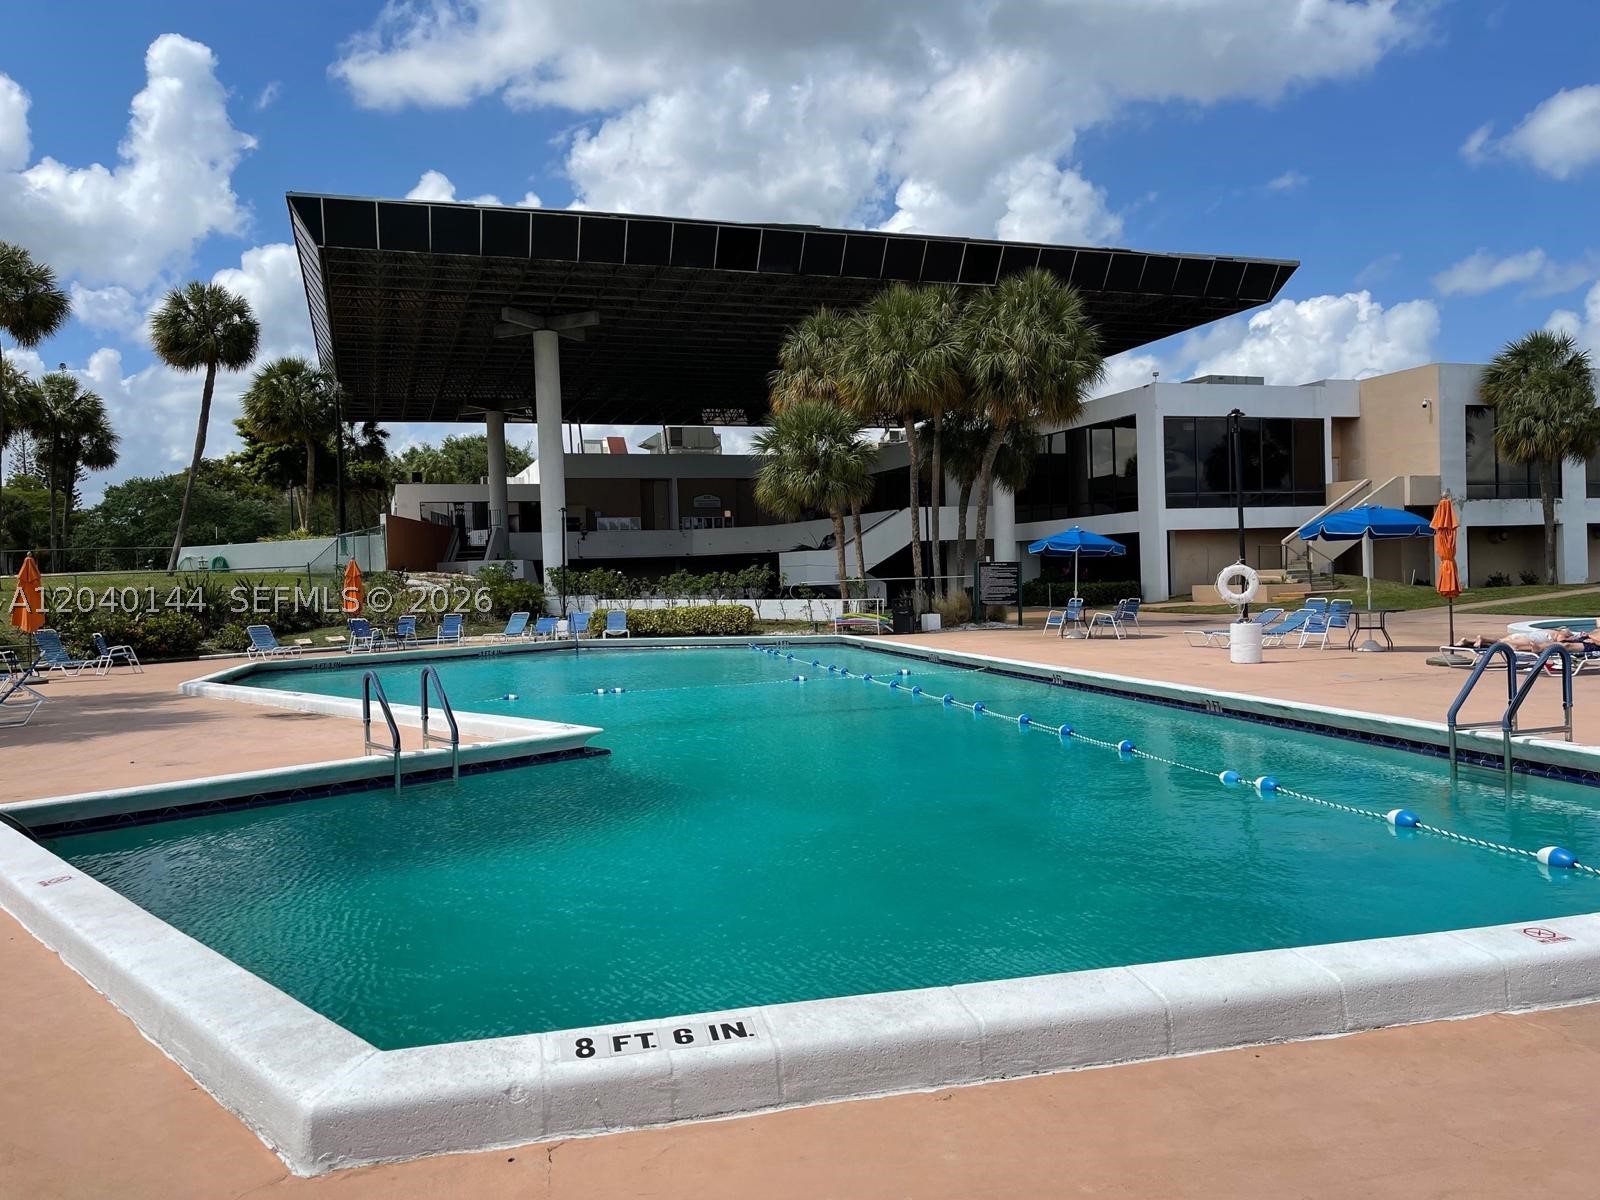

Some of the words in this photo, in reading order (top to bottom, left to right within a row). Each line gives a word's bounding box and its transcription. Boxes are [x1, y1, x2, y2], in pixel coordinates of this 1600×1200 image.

[575, 1037, 596, 1059] 8
[612, 1032, 657, 1053] FT.
[672, 1028, 695, 1045] 6
[708, 1021, 755, 1041] IN.
